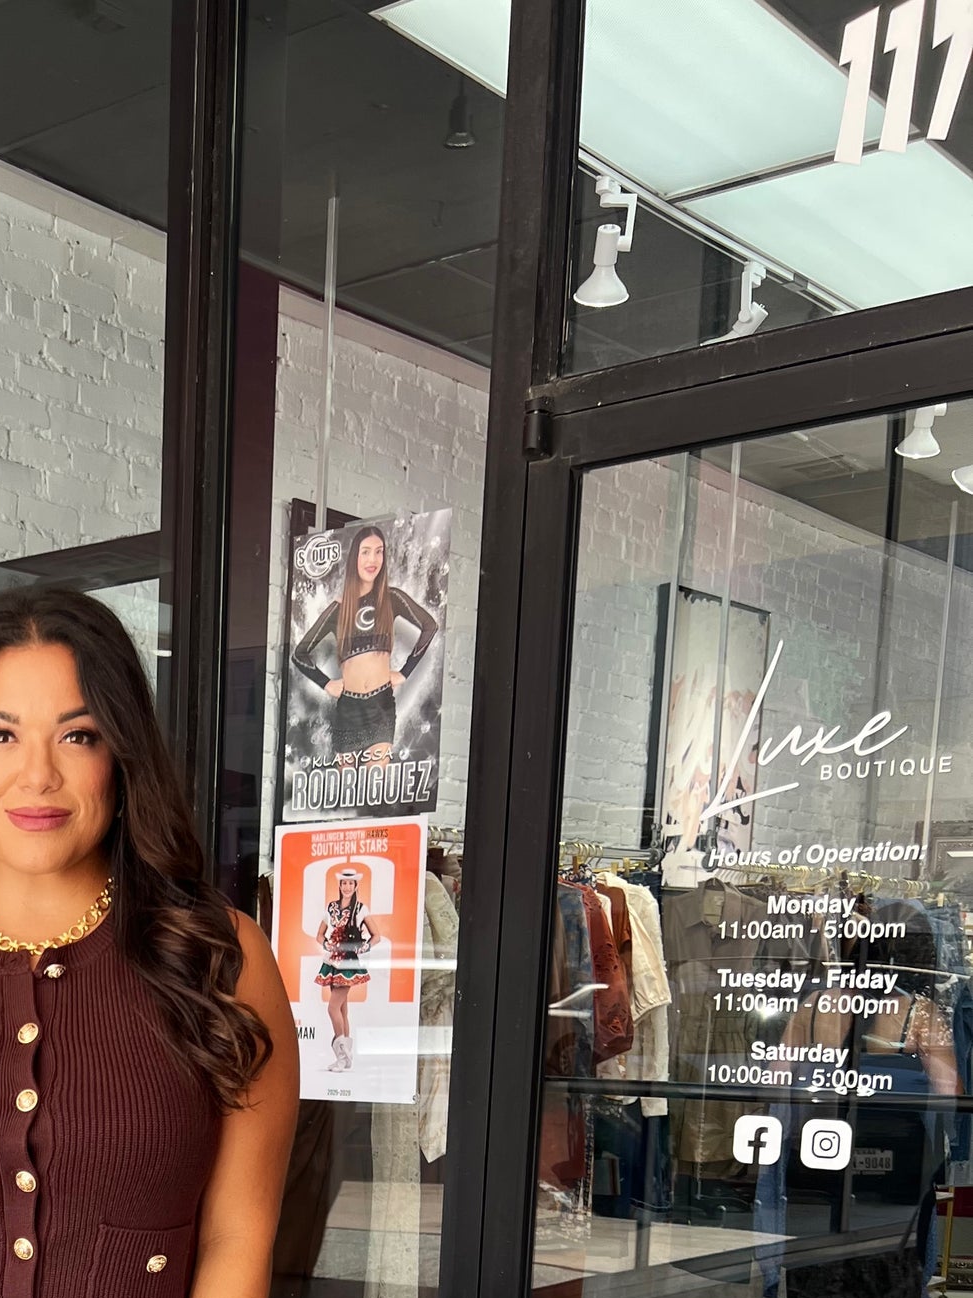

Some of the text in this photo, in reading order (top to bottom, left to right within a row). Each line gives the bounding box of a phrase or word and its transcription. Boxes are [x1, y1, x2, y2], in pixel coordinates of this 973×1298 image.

[834, 0, 973, 165] 117
[698, 639, 908, 820] Luxe
[312, 747, 393, 768] KLARYSSA
[819, 755, 953, 781] BOUTIQUE
[291, 760, 432, 811] RODRIGUEZ
[311, 832, 344, 843] HARLINGEN
[345, 830, 366, 841] SOUTH
[311, 838, 388, 857] SOUTHERN STARS
[708, 840, 928, 868] Hours of Operation:
[766, 895, 856, 918] Monday
[717, 920, 804, 940] 11:00am
[823, 920, 906, 943] 5:00pm
[716, 968, 806, 992] Tuesday
[826, 969, 898, 994] Friday
[712, 994, 798, 1013] 11:00am
[817, 994, 900, 1018] 6:00pm
[750, 1040, 849, 1067] Saturday
[707, 1065, 793, 1086] 10:00am
[811, 1068, 893, 1094] 5:00pm
